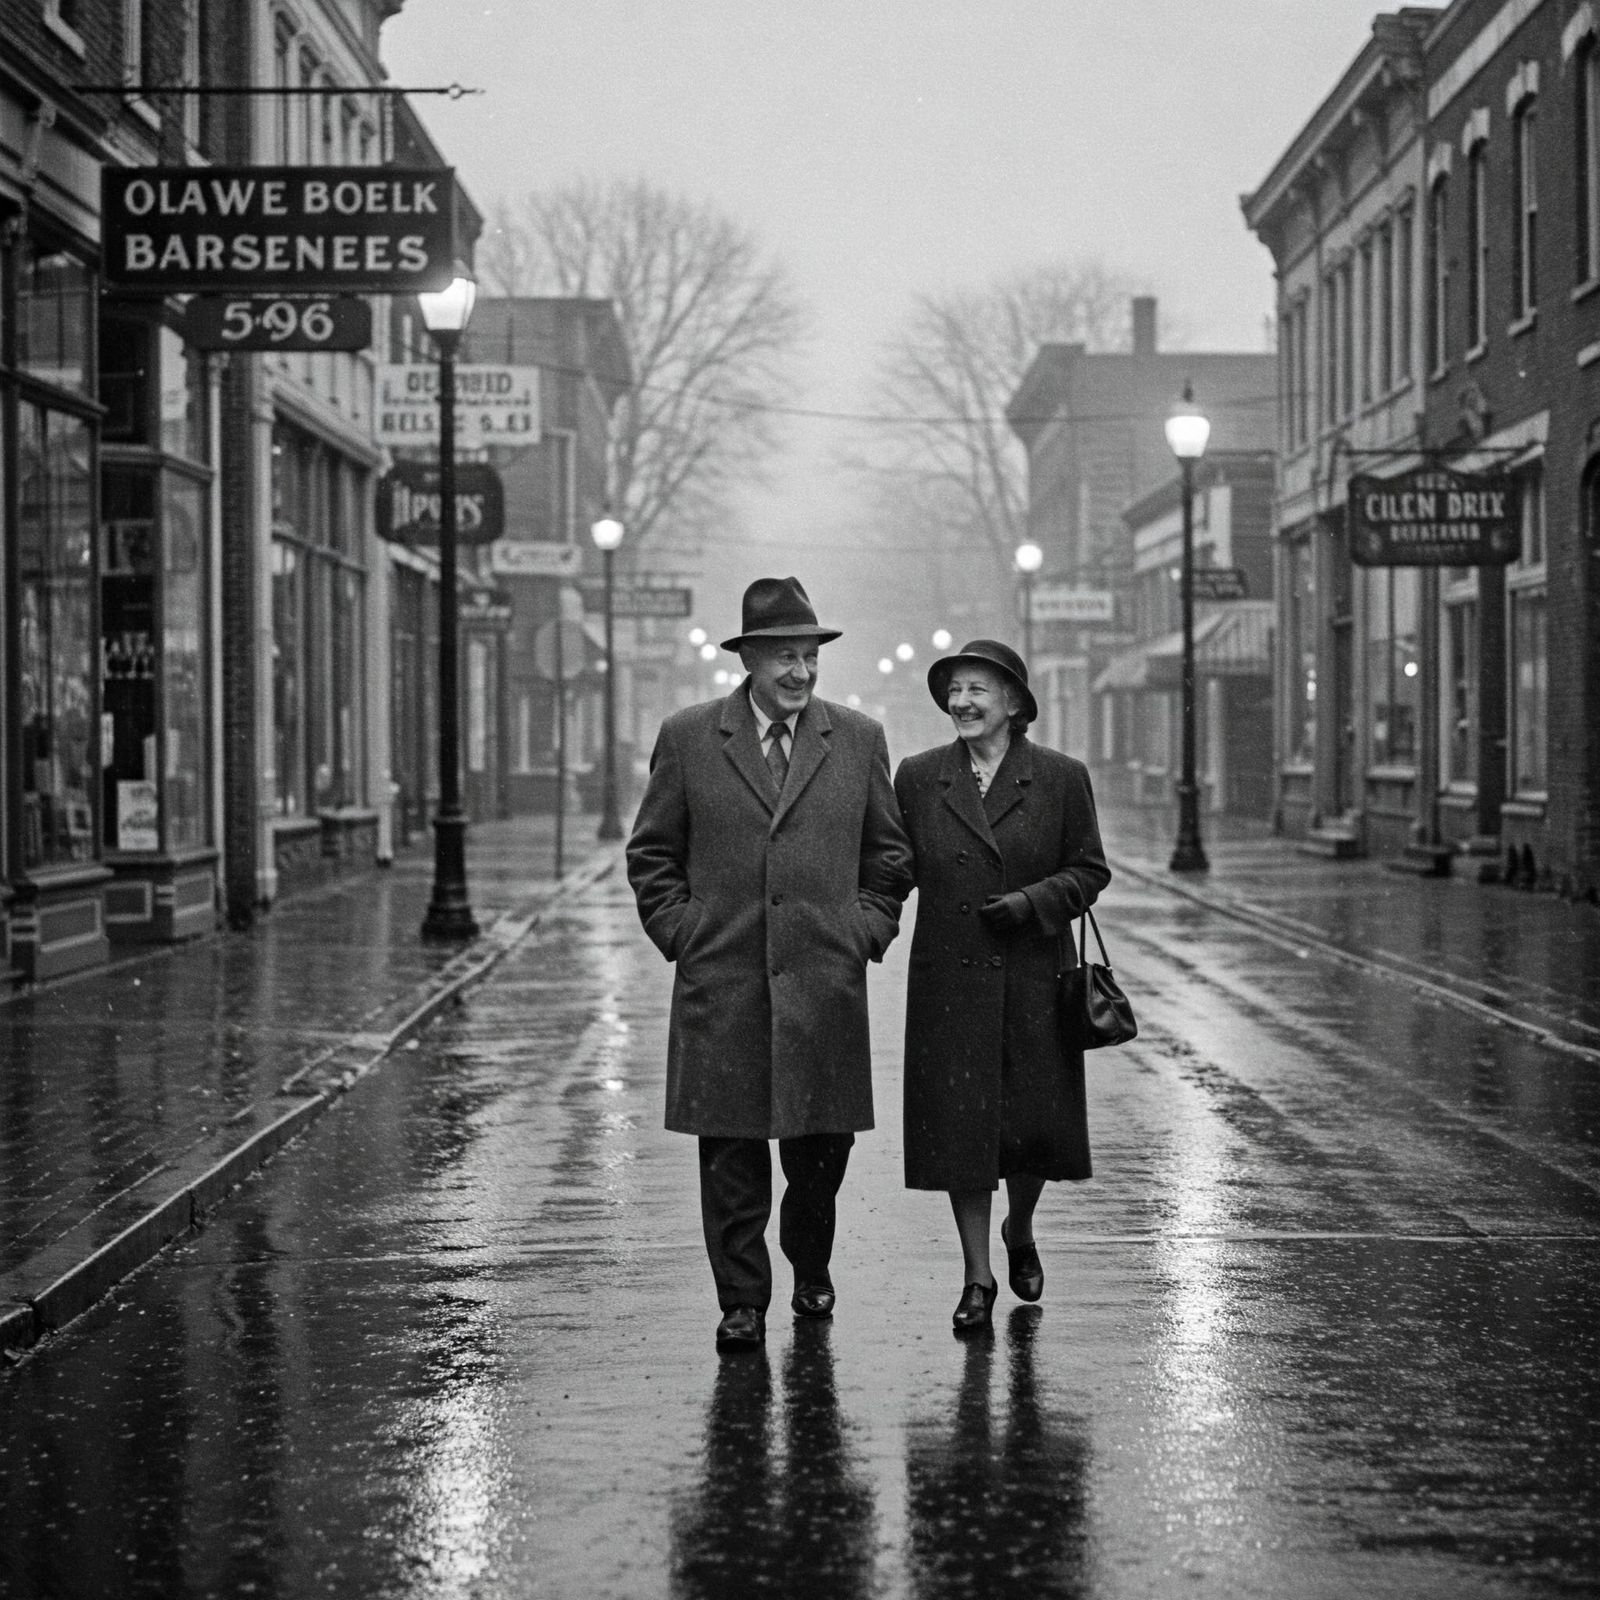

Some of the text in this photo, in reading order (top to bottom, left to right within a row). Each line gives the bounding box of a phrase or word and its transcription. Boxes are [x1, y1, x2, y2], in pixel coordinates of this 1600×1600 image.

[124, 179, 438, 216] OLAWE BOELK
[125, 233, 429, 272] BARSENEES
